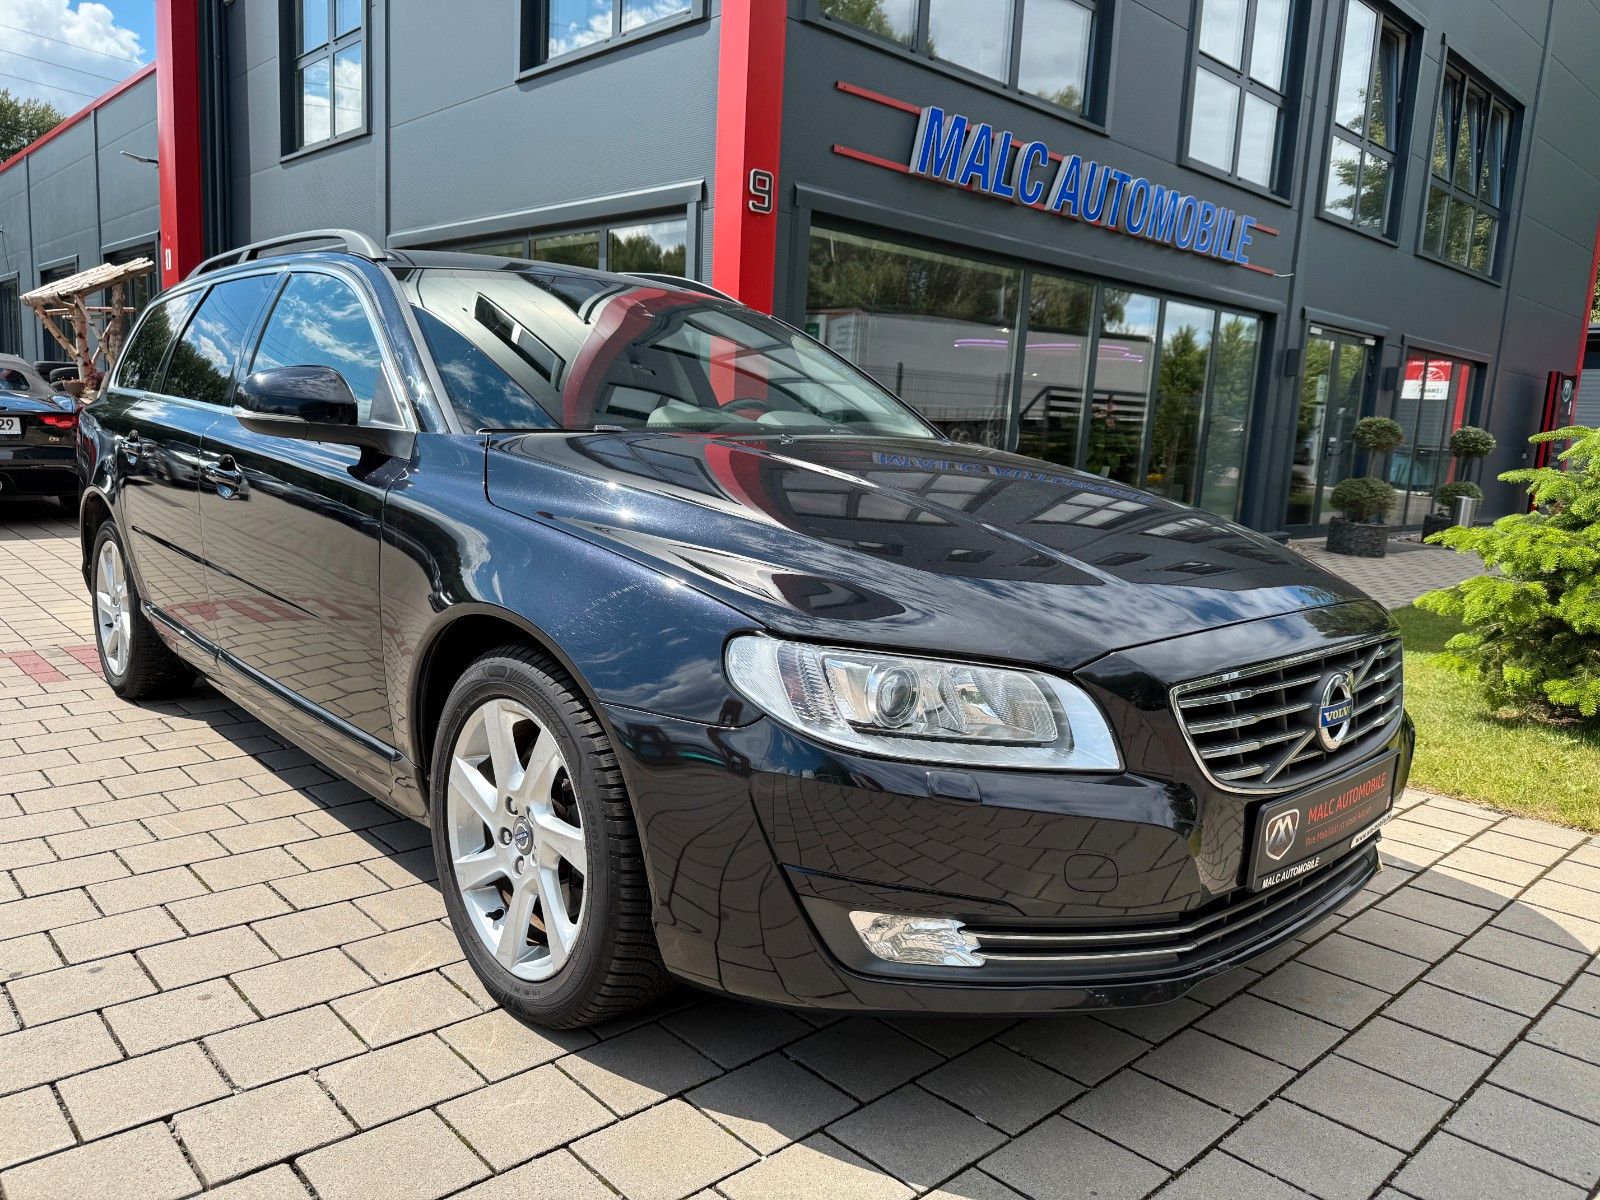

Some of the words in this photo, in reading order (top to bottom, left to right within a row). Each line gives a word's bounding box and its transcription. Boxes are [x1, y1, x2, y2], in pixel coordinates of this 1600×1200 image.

[749, 168, 774, 214] 9
[911, 106, 1049, 205] MALC
[1048, 155, 1256, 264] AUTOMOBILE
[1308, 799, 1335, 825] MALC
[1335, 772, 1387, 811] AUTOMOBILE
[1262, 873, 1281, 890] MALC
[1281, 857, 1320, 881] AUTOMOBILE
